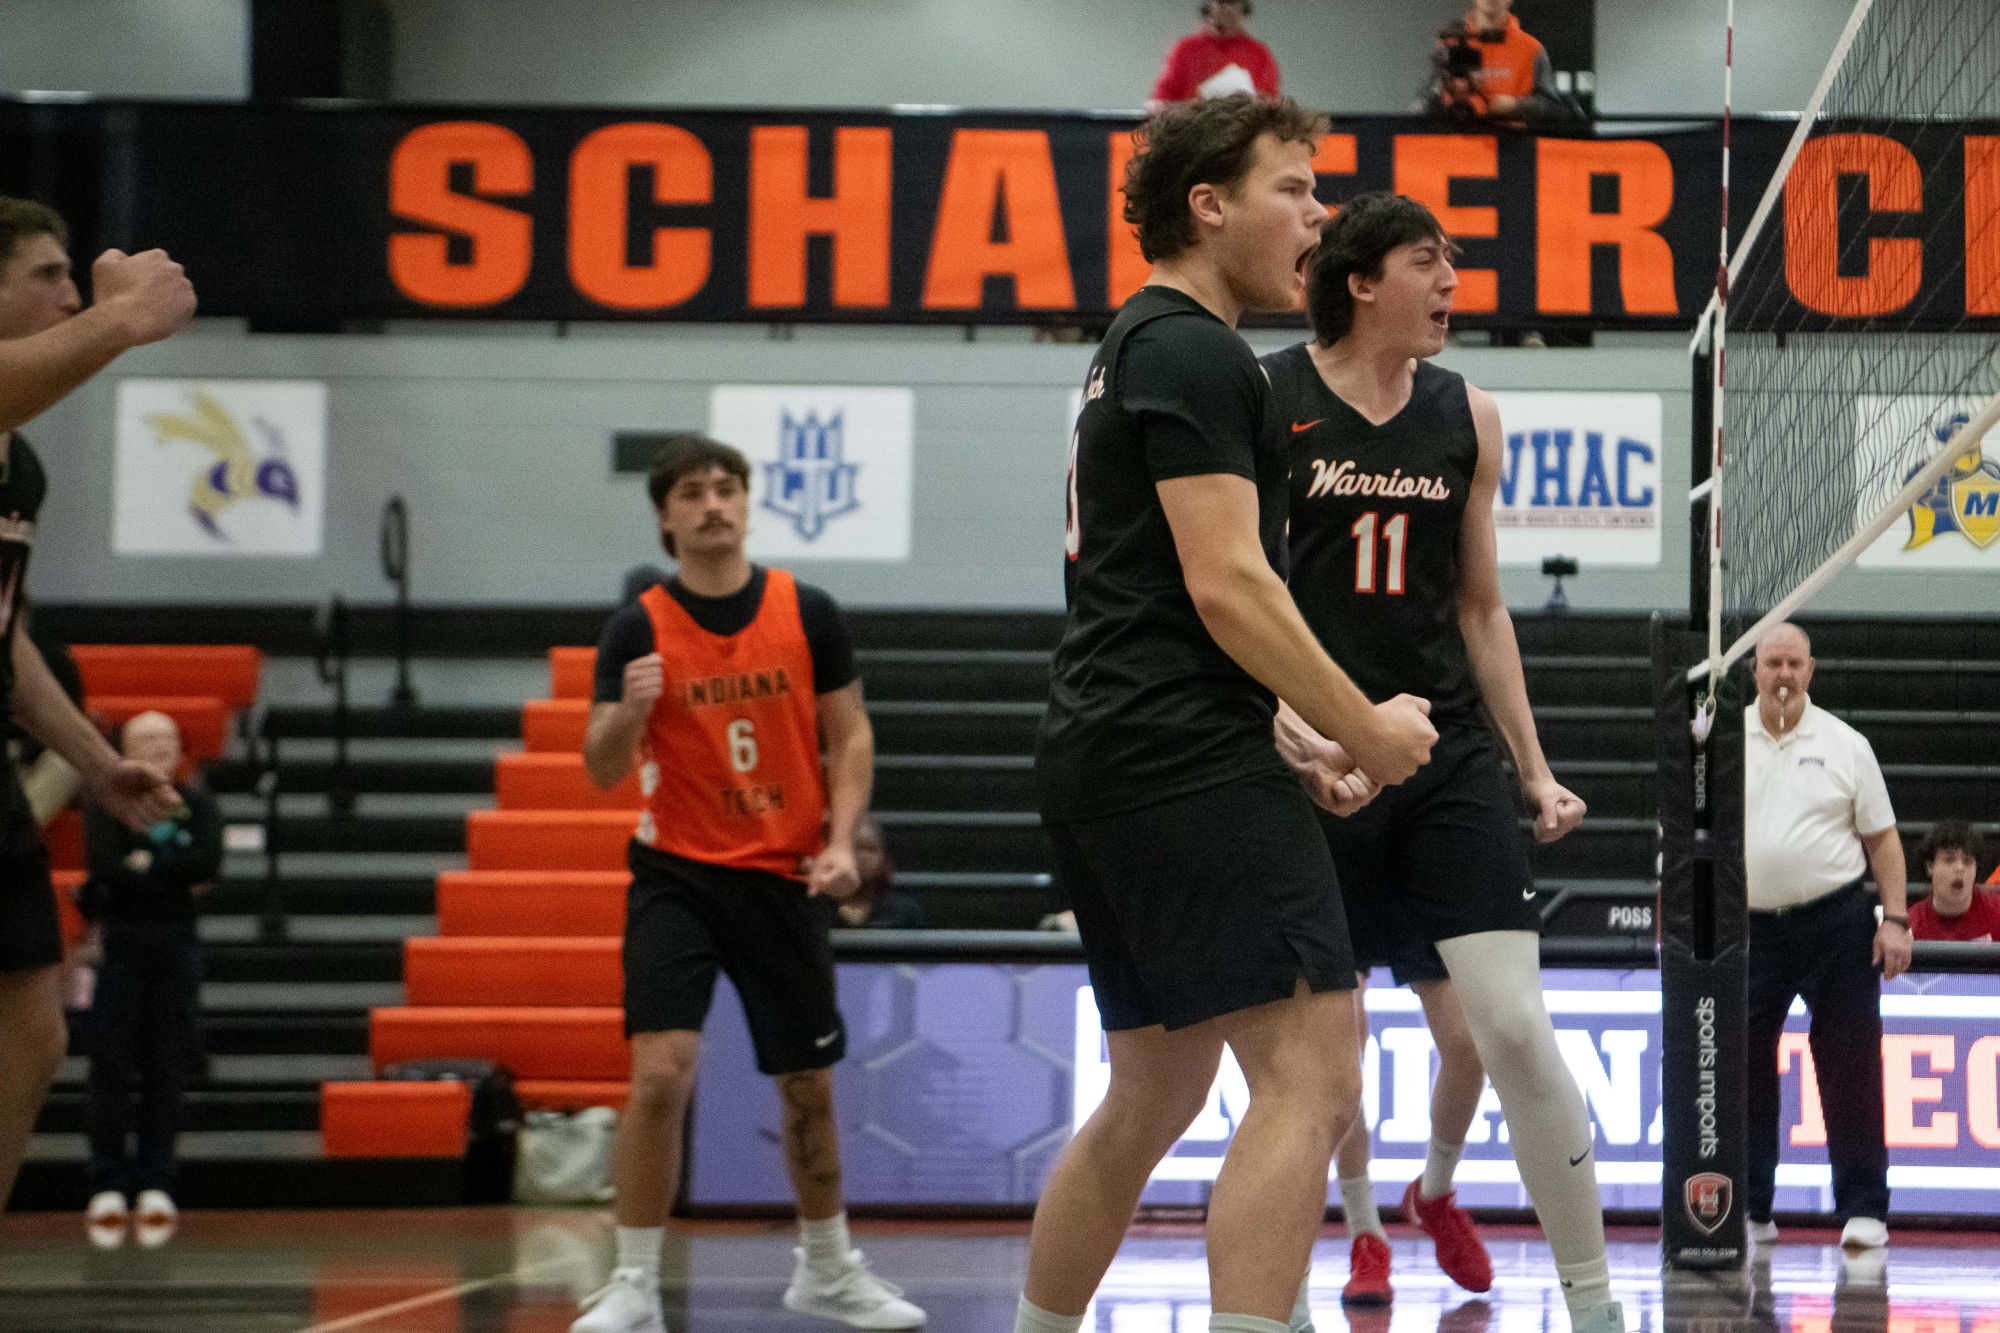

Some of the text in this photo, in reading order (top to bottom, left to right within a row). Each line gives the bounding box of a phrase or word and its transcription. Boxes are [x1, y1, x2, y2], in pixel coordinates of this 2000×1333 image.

[1306, 458, 1451, 500] Warriors
[1964, 491, 2000, 516] M
[1351, 511, 1409, 595] 11
[681, 668, 791, 708] INDIANA
[727, 718, 758, 773] 6
[1608, 906, 1652, 929] POSS
[1694, 996, 1719, 1158] sports imports
